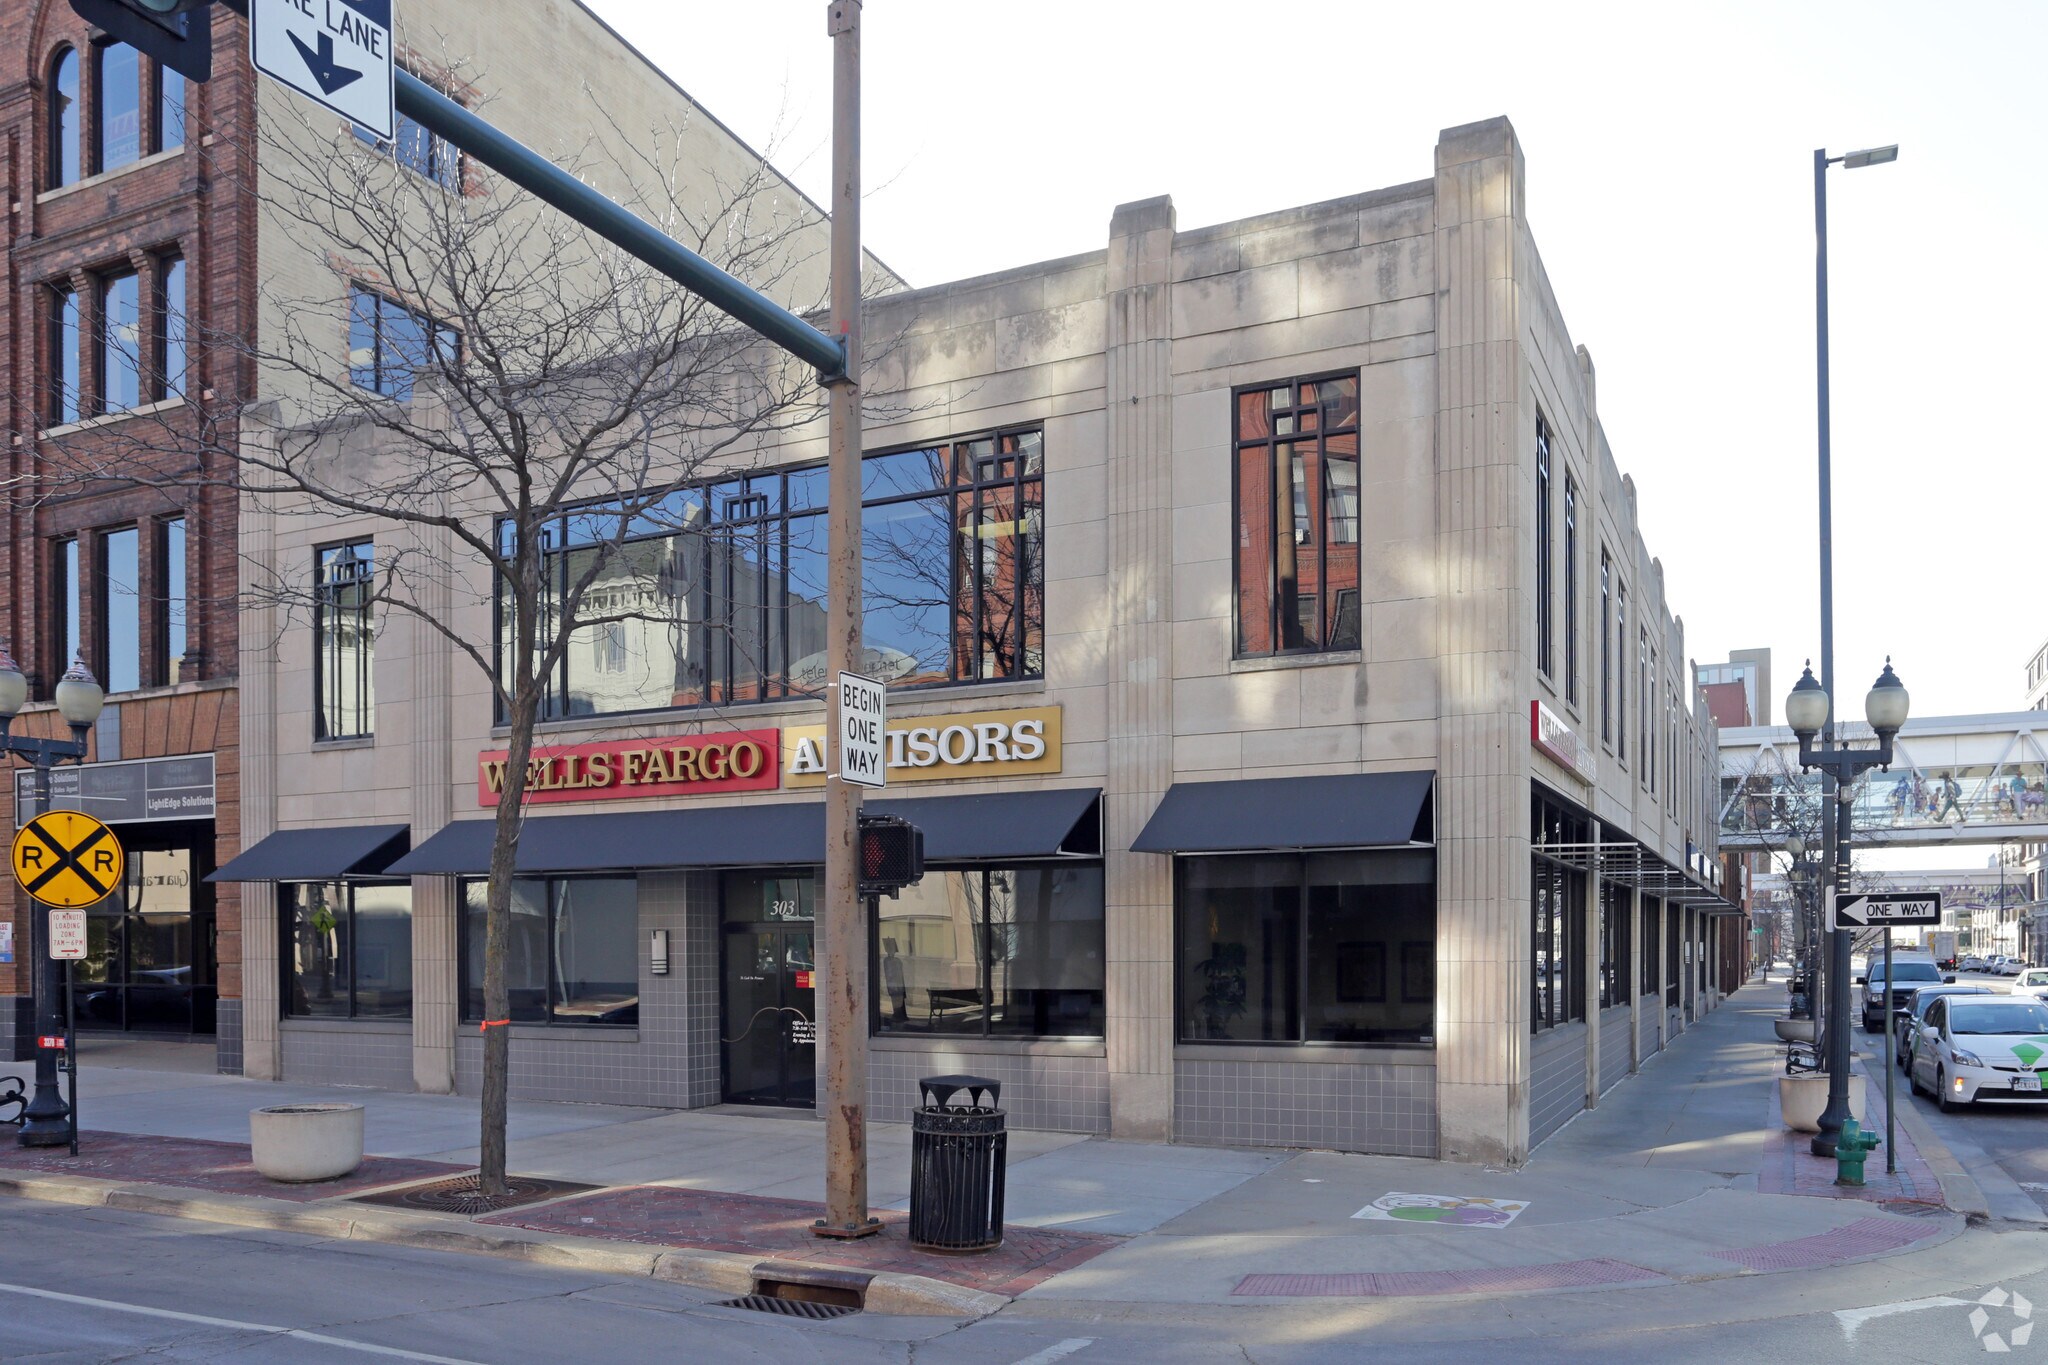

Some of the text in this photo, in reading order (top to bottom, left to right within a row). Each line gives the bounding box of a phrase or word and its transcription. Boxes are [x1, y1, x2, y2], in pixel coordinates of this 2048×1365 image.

[326, 0, 383, 60] LANE
[843, 684, 881, 715] BEGIN
[847, 716, 877, 745] ONE
[620, 741, 764, 785] FARGO
[787, 719, 1045, 774] AISORS
[846, 747, 878, 775] WAY
[148, 795, 215, 811] LightEdge Solutions
[22, 846, 114, 872] R R
[770, 900, 795, 916] 303
[1866, 903, 1929, 916] ONE WAY
